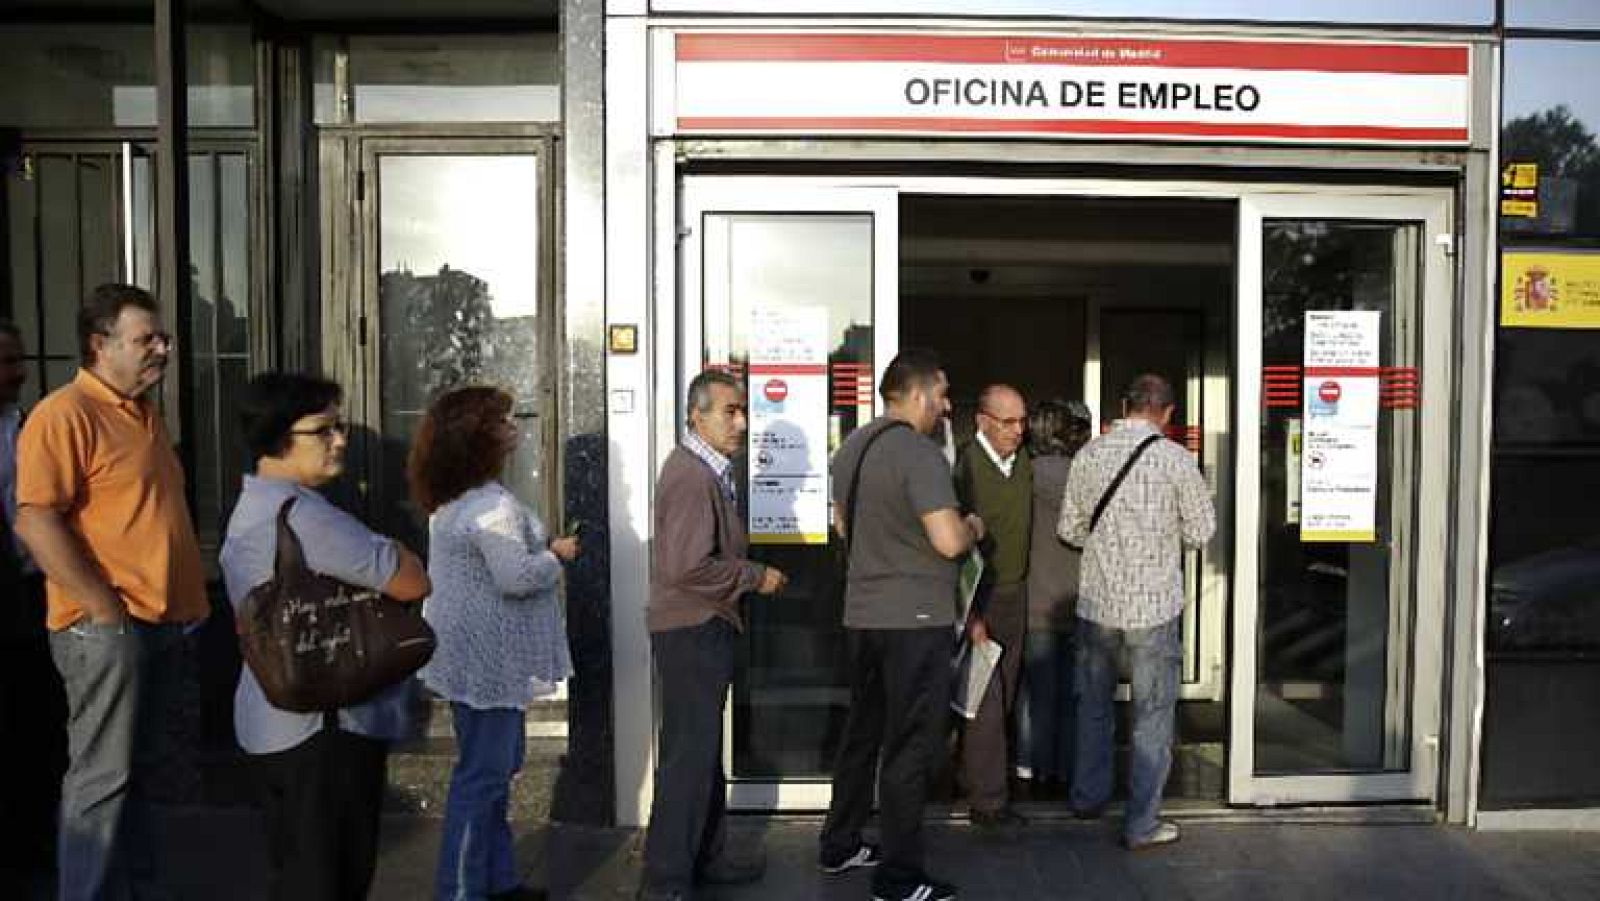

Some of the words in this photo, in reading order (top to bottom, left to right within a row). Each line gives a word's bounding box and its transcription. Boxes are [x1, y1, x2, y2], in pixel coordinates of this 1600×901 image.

[904, 78, 1048, 107] OFICINA
[1060, 81, 1106, 107] DE
[1118, 82, 1261, 112] EMPLEO
